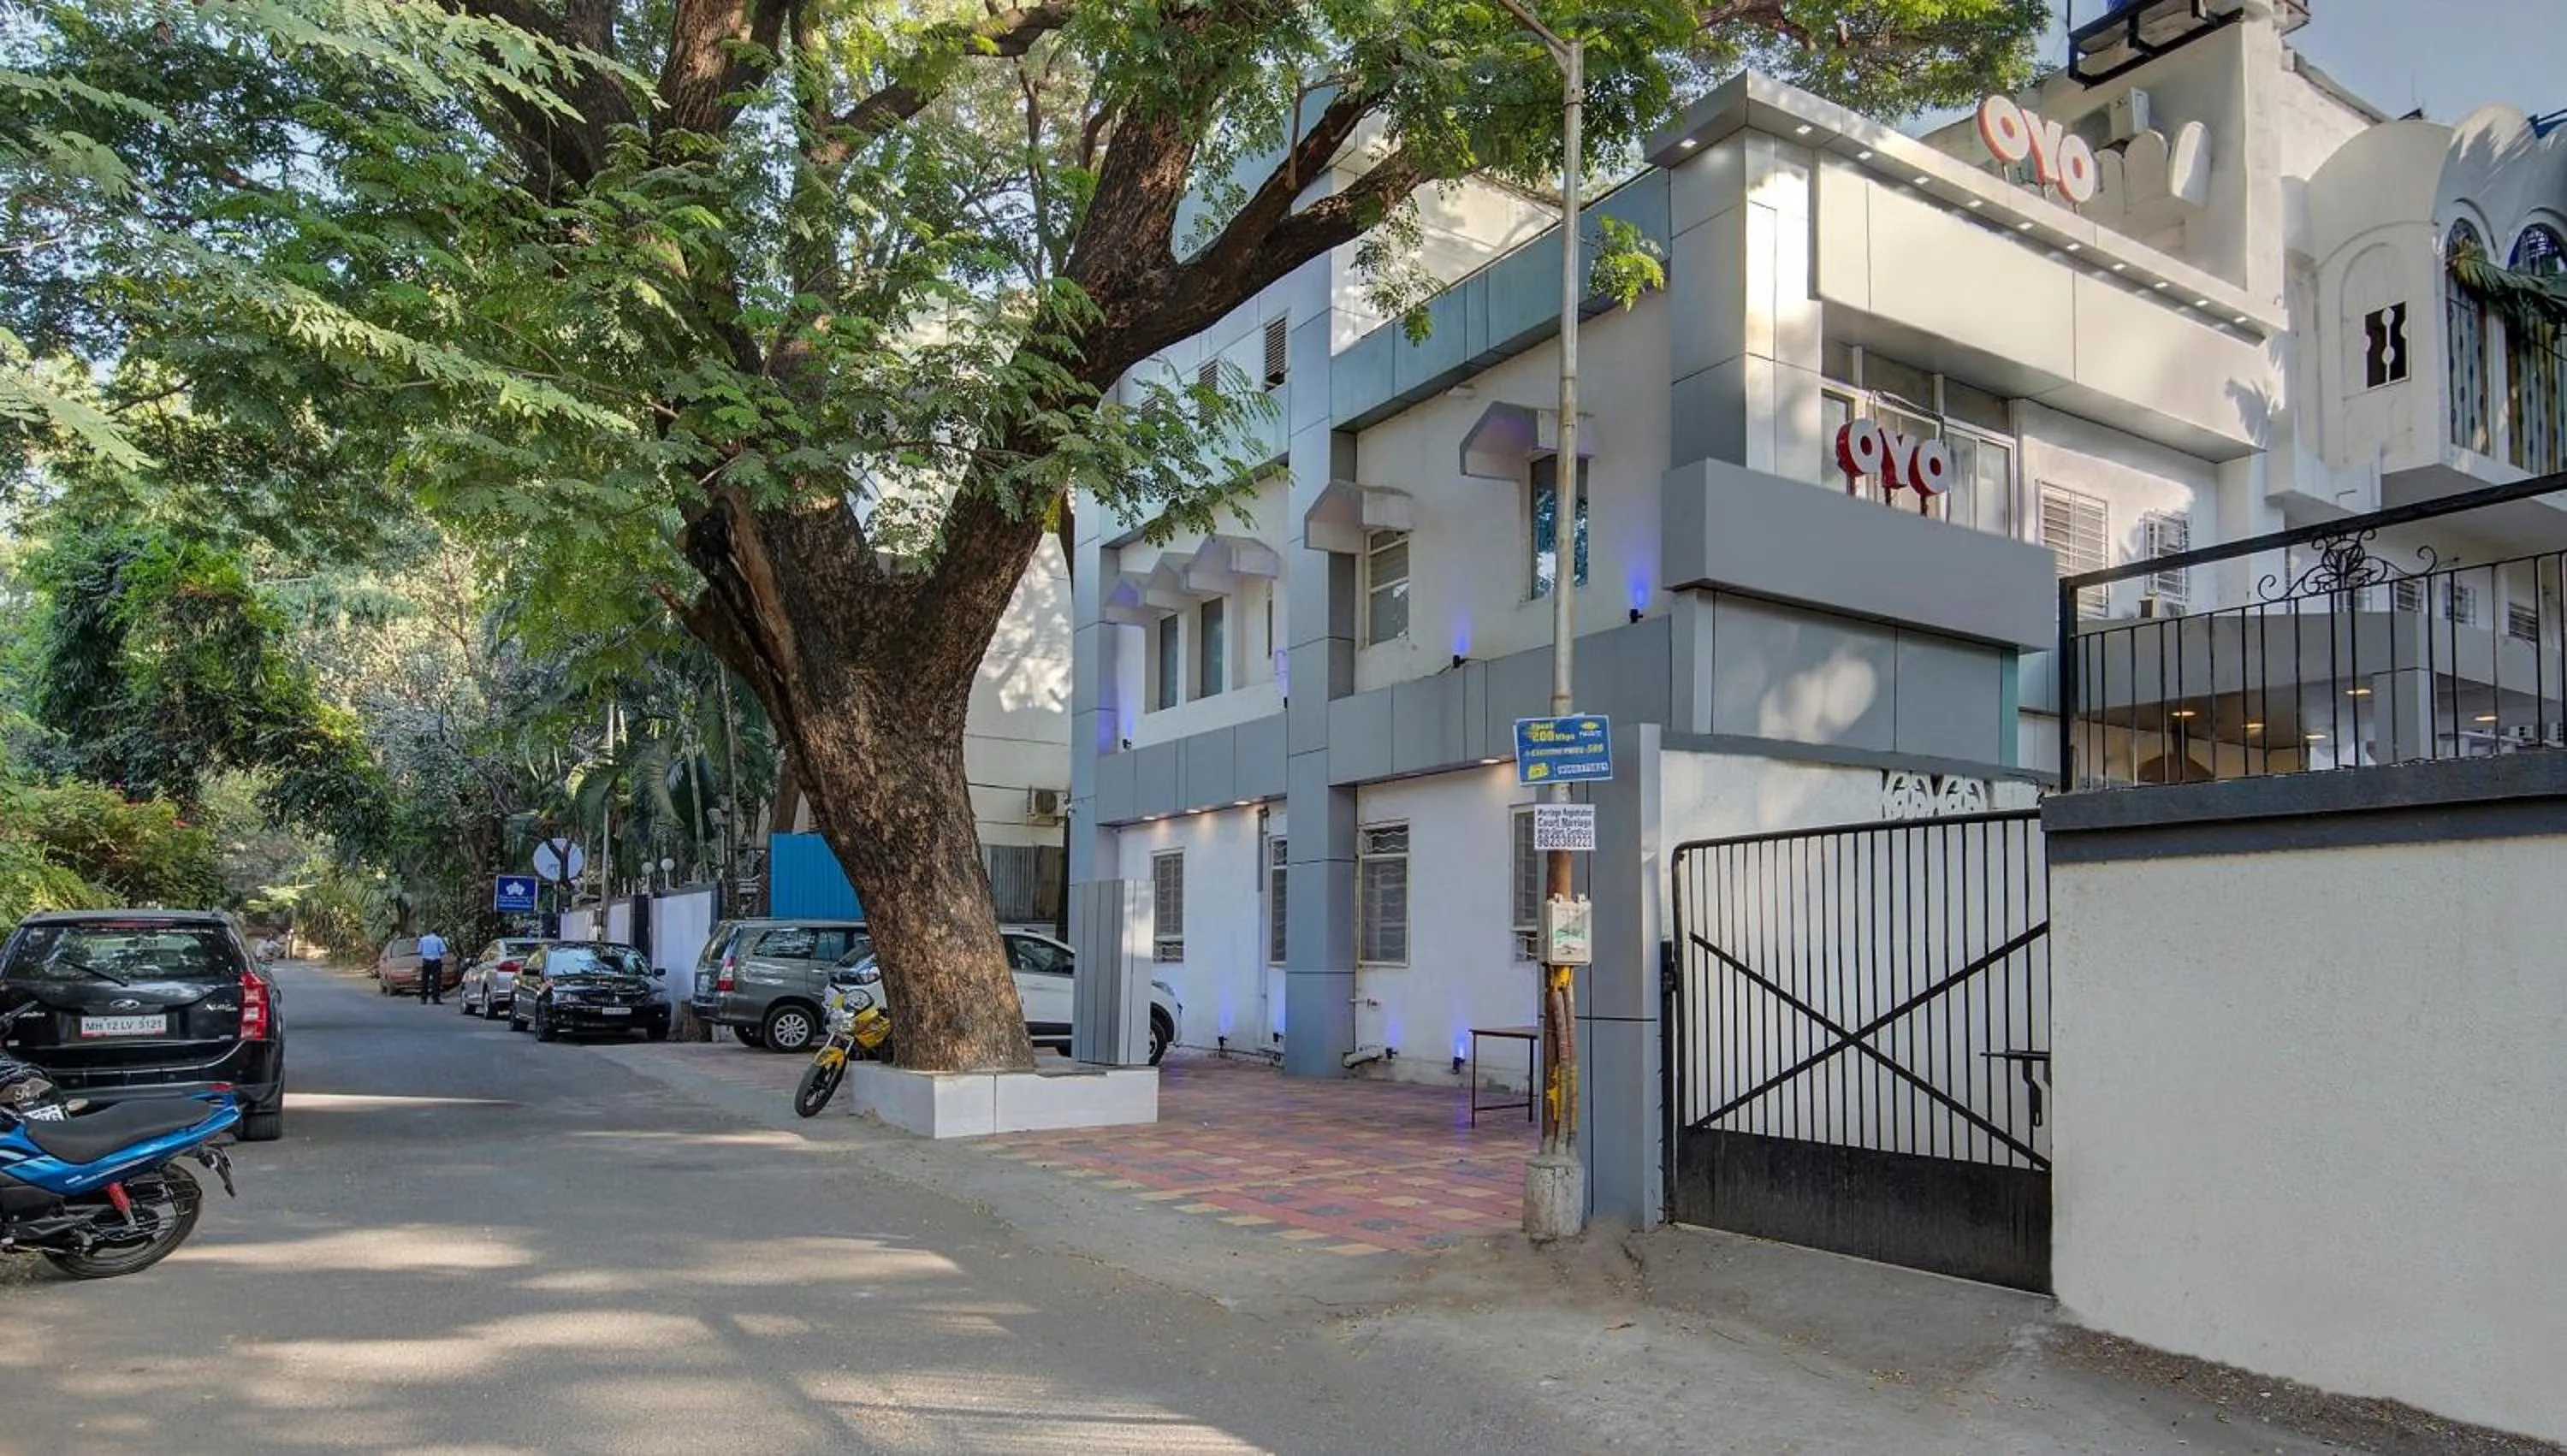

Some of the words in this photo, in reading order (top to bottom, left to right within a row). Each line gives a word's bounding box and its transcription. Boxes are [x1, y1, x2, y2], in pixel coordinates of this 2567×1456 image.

[1977, 95, 2096, 203] OYO
[1836, 419, 1952, 496] OYO
[1538, 808, 1561, 819] Marriage
[1538, 818, 1560, 828] Court
[1562, 818, 1592, 828] Marriage
[85, 1021, 103, 1031] MH
[106, 1021, 118, 1030] 12
